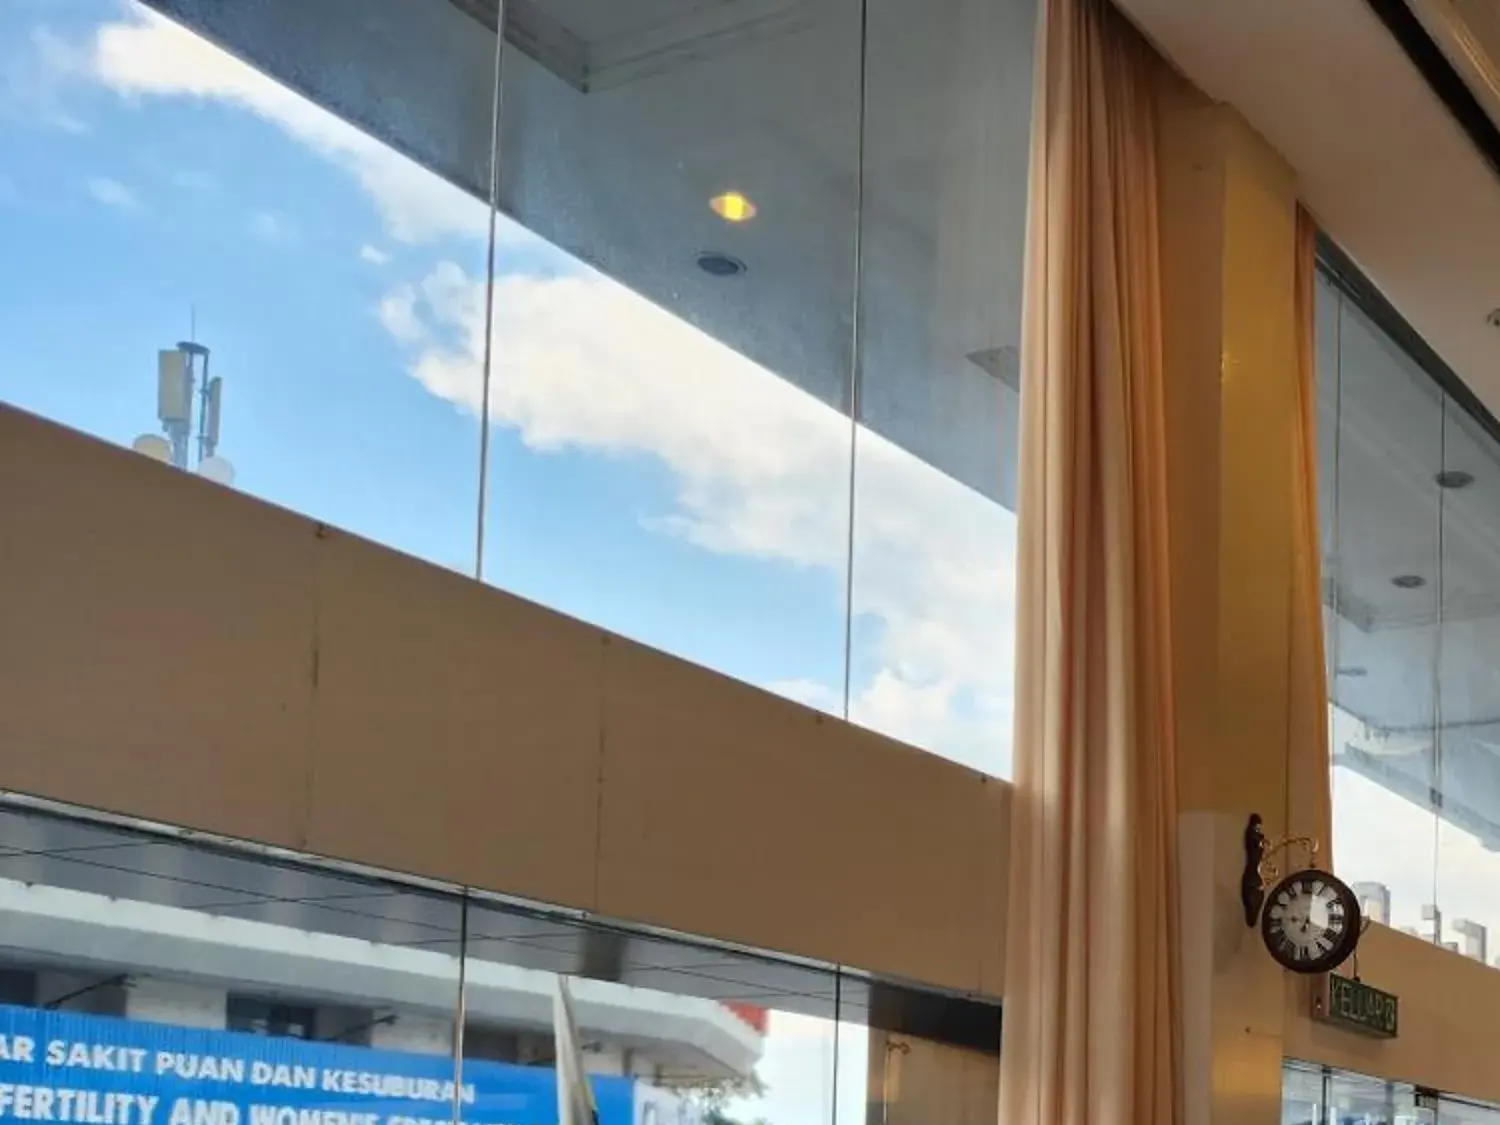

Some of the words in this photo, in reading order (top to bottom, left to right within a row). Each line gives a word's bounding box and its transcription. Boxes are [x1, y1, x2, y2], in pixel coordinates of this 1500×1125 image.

[46, 1040, 148, 1073] SAKIT
[155, 1051, 244, 1082] PUAN
[251, 1060, 316, 1089] DAN
[322, 1068, 476, 1104] KESUBURAN
